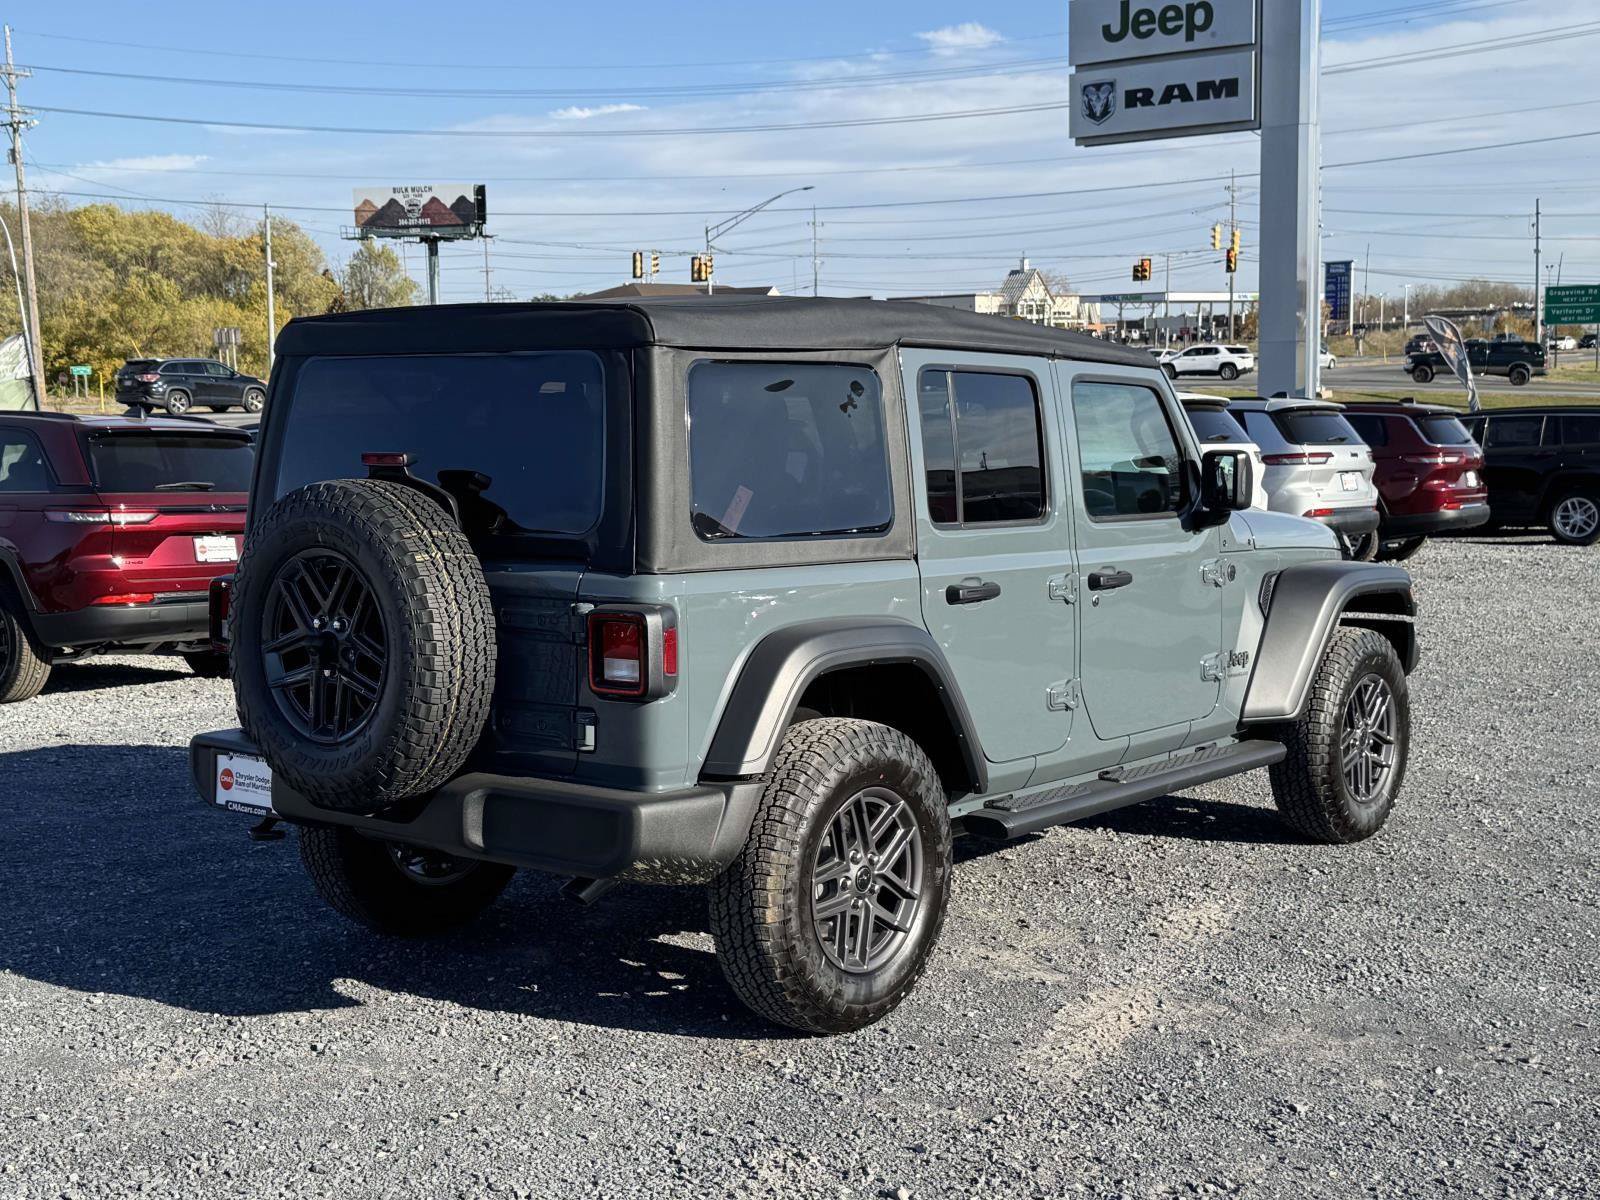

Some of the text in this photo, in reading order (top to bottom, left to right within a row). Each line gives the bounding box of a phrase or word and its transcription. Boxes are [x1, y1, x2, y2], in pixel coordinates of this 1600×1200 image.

[1102, 0, 1214, 43] Jeep
[1124, 77, 1239, 109] RAM
[1226, 649, 1249, 669] Jeep
[235, 772, 270, 786] Chrysler Dodge
[235, 779, 246, 787] Ram
[228, 802, 266, 816] CMAcars.com
